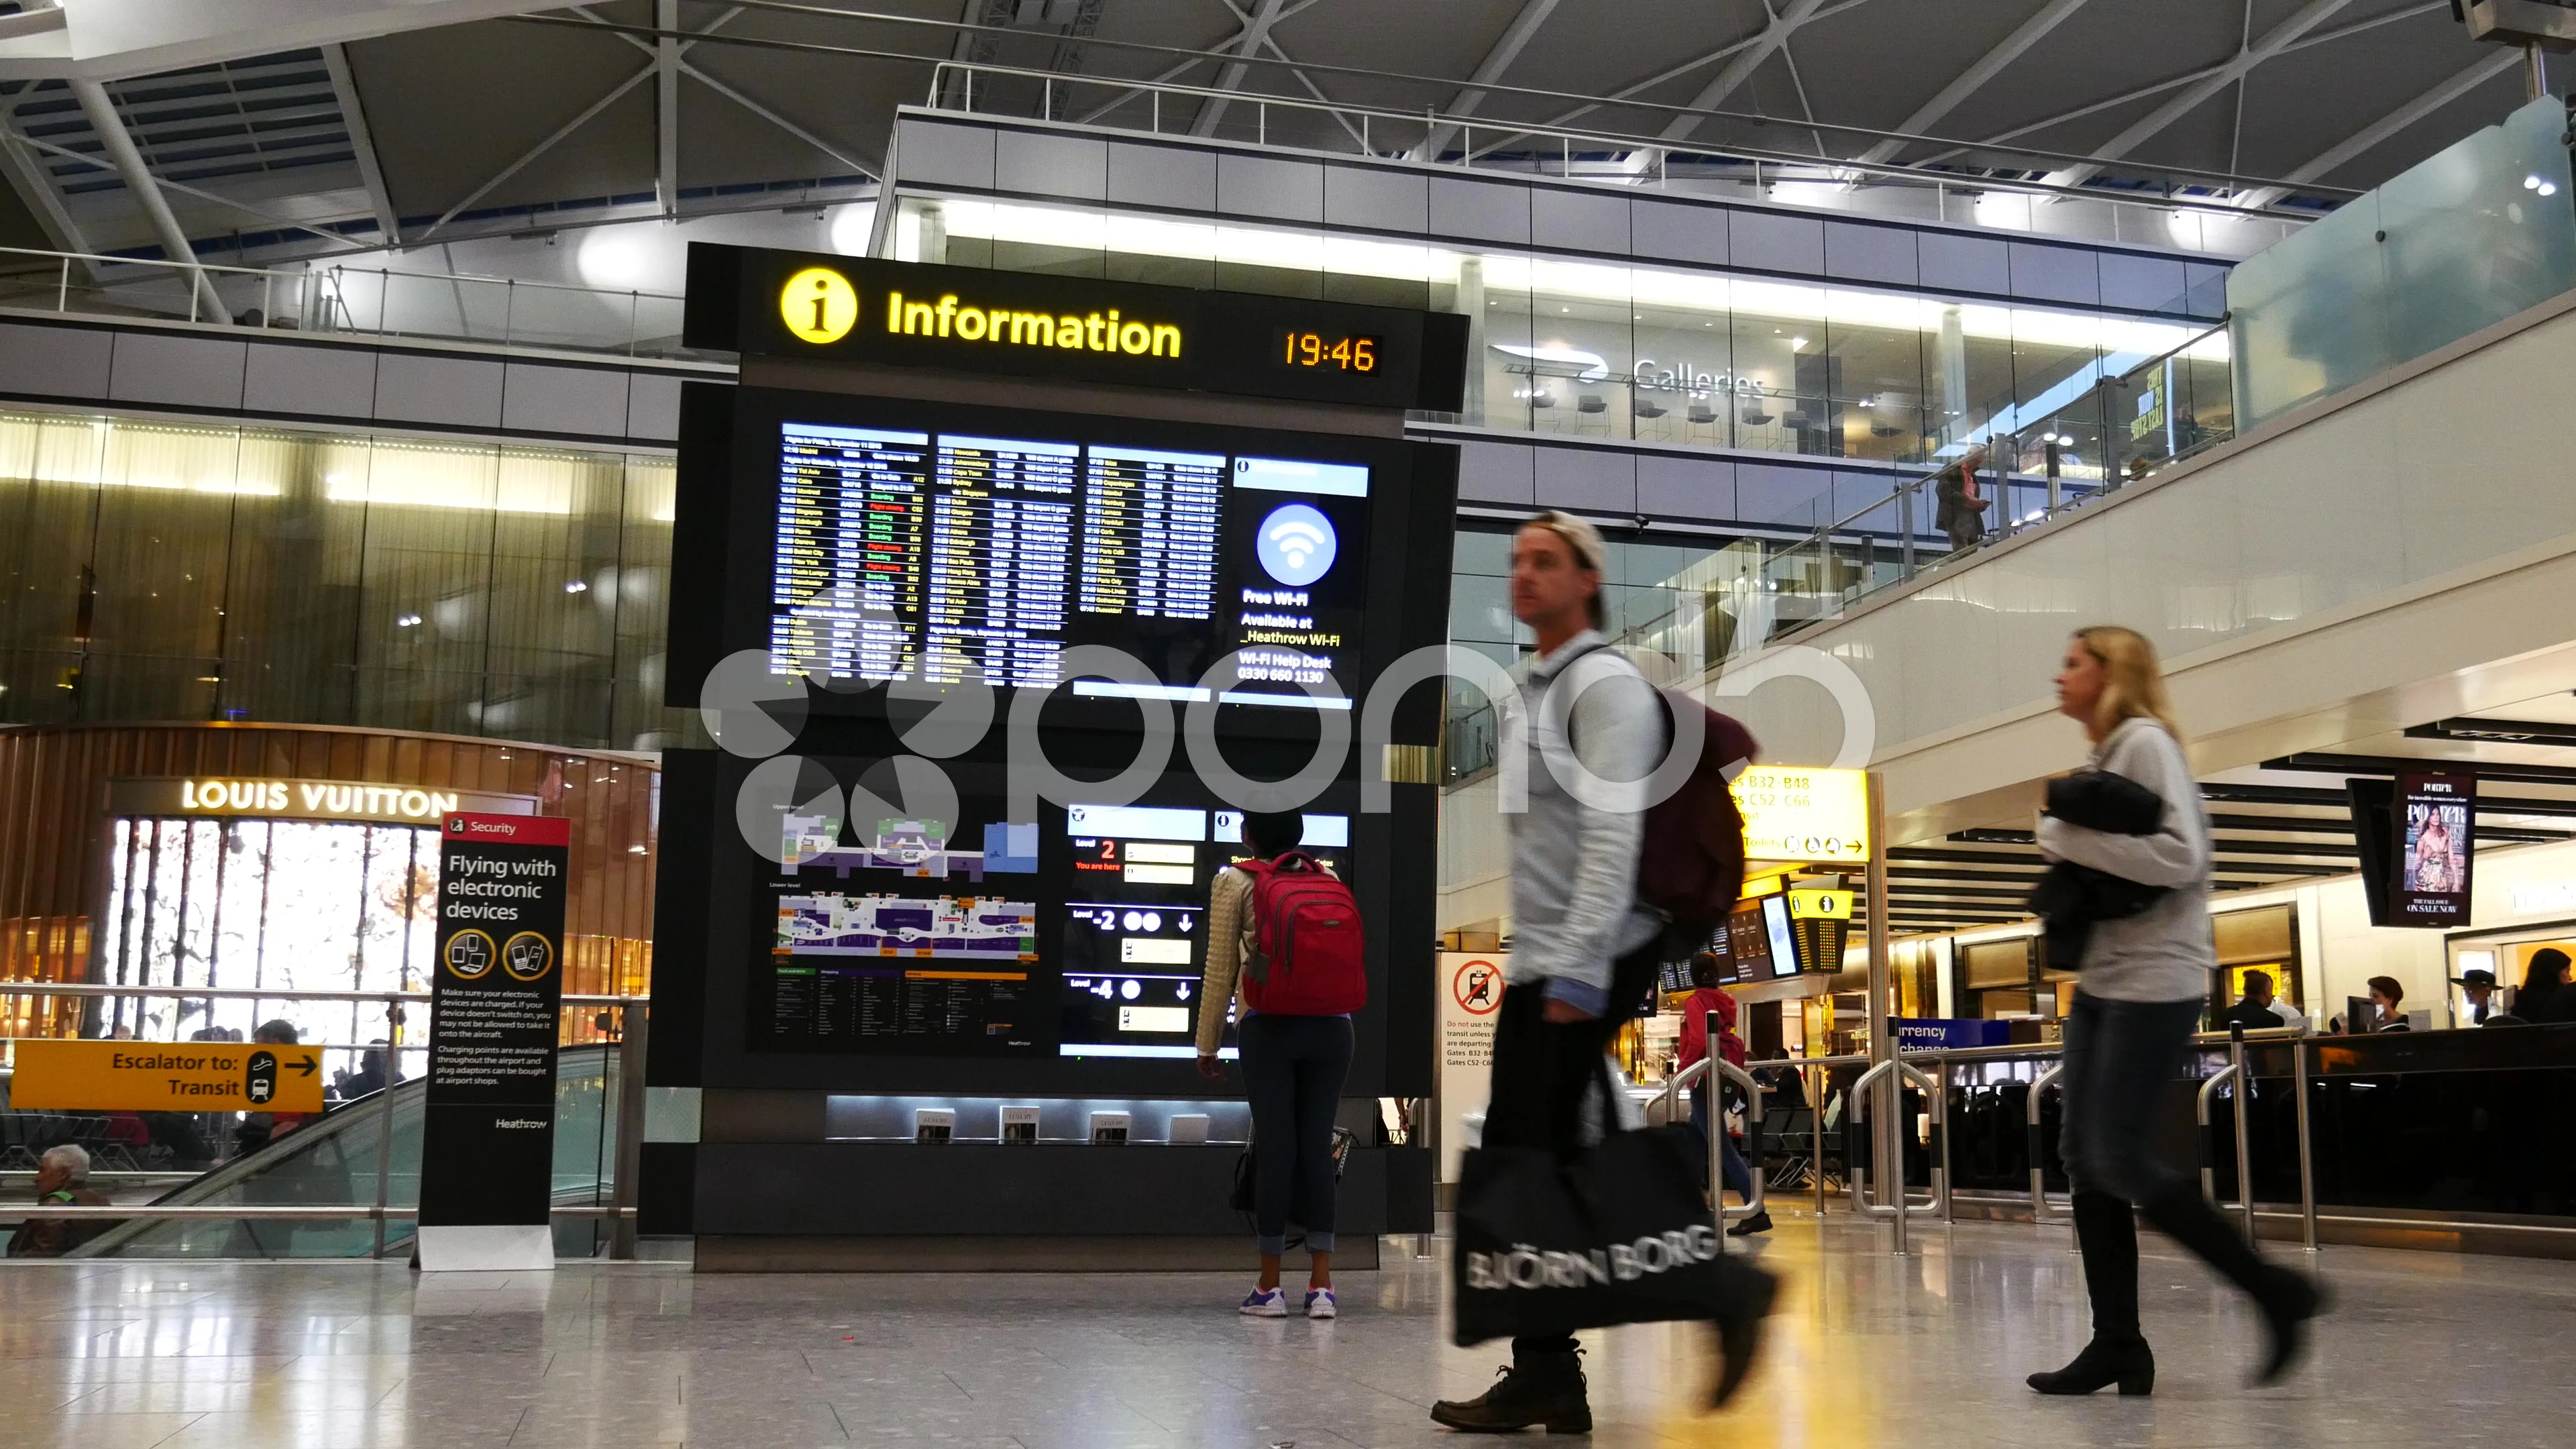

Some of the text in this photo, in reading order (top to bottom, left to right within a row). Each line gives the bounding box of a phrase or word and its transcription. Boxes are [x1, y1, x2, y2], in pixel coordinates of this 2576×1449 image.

[888, 291, 1183, 358] Information
[1287, 331, 1375, 372] 19:46
[1633, 359, 1766, 400] Galleries
[869, 513, 893, 521] Boarding
[867, 553, 891, 561] Boarding
[1243, 590, 1307, 606] Free Wi-Fi
[1241, 613, 1313, 629] Available at
[1240, 631, 1340, 647] _Heathrow Wi-Fi
[1239, 651, 1332, 669] Wi-Fi Help Desk
[1238, 667, 1324, 684] 0330 660 1130
[183, 780, 458, 818] LOUIS VUITTON
[2407, 804, 2467, 824] POTER
[470, 822, 516, 835] Security
[1075, 839, 1114, 859] Level 2
[449, 855, 556, 877] Flying with
[447, 878, 541, 898] electronic
[446, 901, 518, 920] devices
[1093, 910, 1115, 930] -2
[1090, 979, 1114, 1000] -4
[1899, 1027, 1946, 1041] rrency
[437, 1046, 474, 1055] Charging
[1459, 1040, 1491, 1048] departing
[113, 1053, 238, 1071] Escalator to:
[437, 1056, 483, 1065] throughout
[498, 1057, 525, 1065] airport
[437, 1067, 455, 1075] plug
[455, 1067, 490, 1075] adaptors
[518, 1068, 546, 1077] bought
[168, 1079, 239, 1096] Transit
[445, 1077, 472, 1085] airport
[496, 1118, 547, 1129] Heathrow
[1466, 1224, 1718, 1289] BJÖRN BORG
